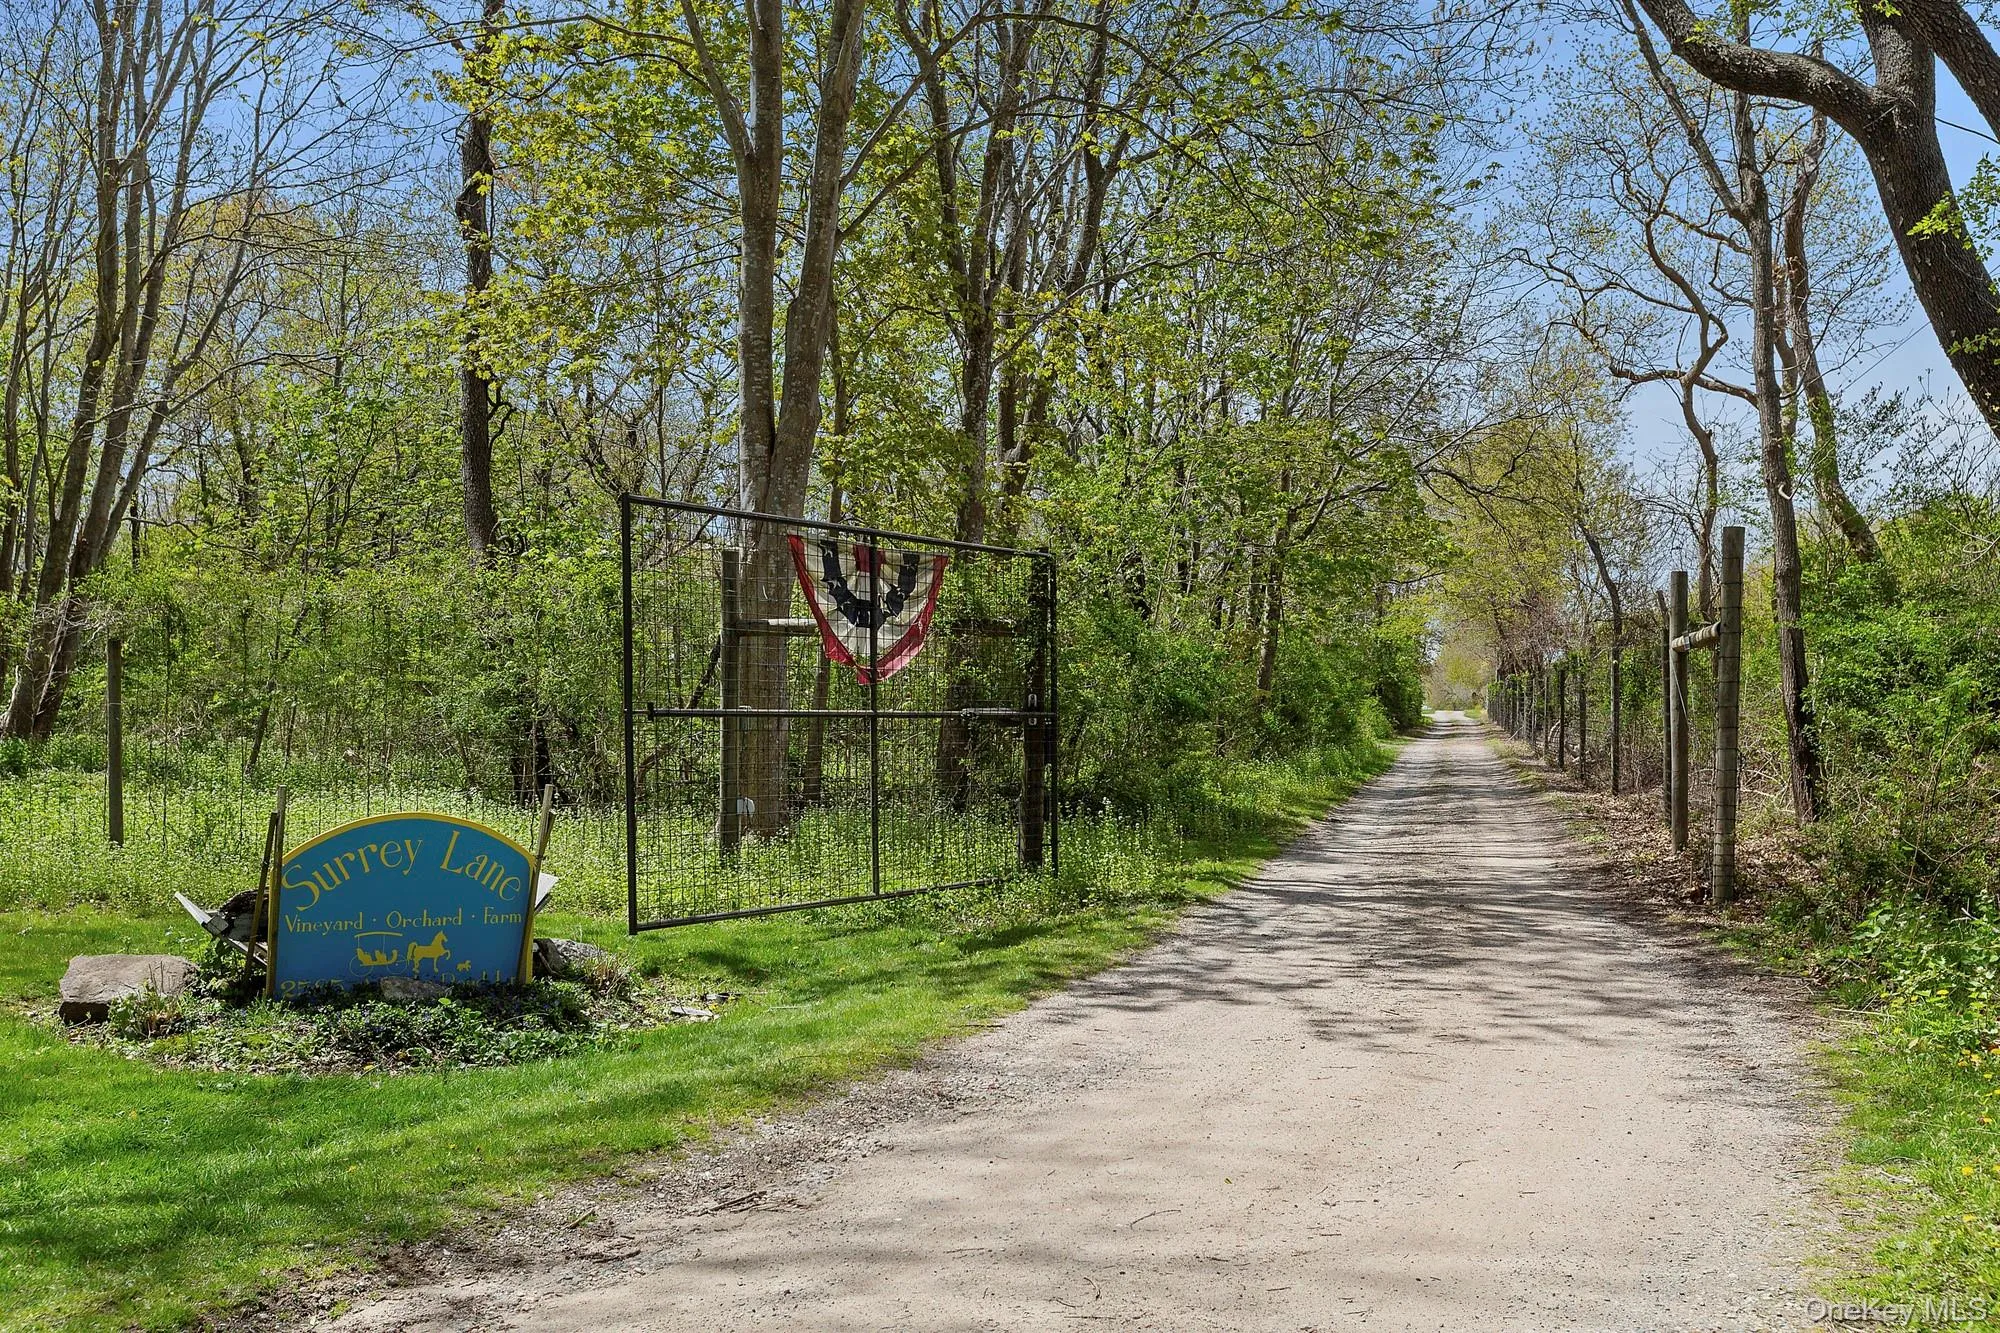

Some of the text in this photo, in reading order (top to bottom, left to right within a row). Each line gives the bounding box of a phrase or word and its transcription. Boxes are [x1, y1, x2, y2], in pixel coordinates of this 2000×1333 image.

[281, 830, 522, 912] Surrey Lane
[284, 906, 522, 937] Vineyard Orchard Farm
